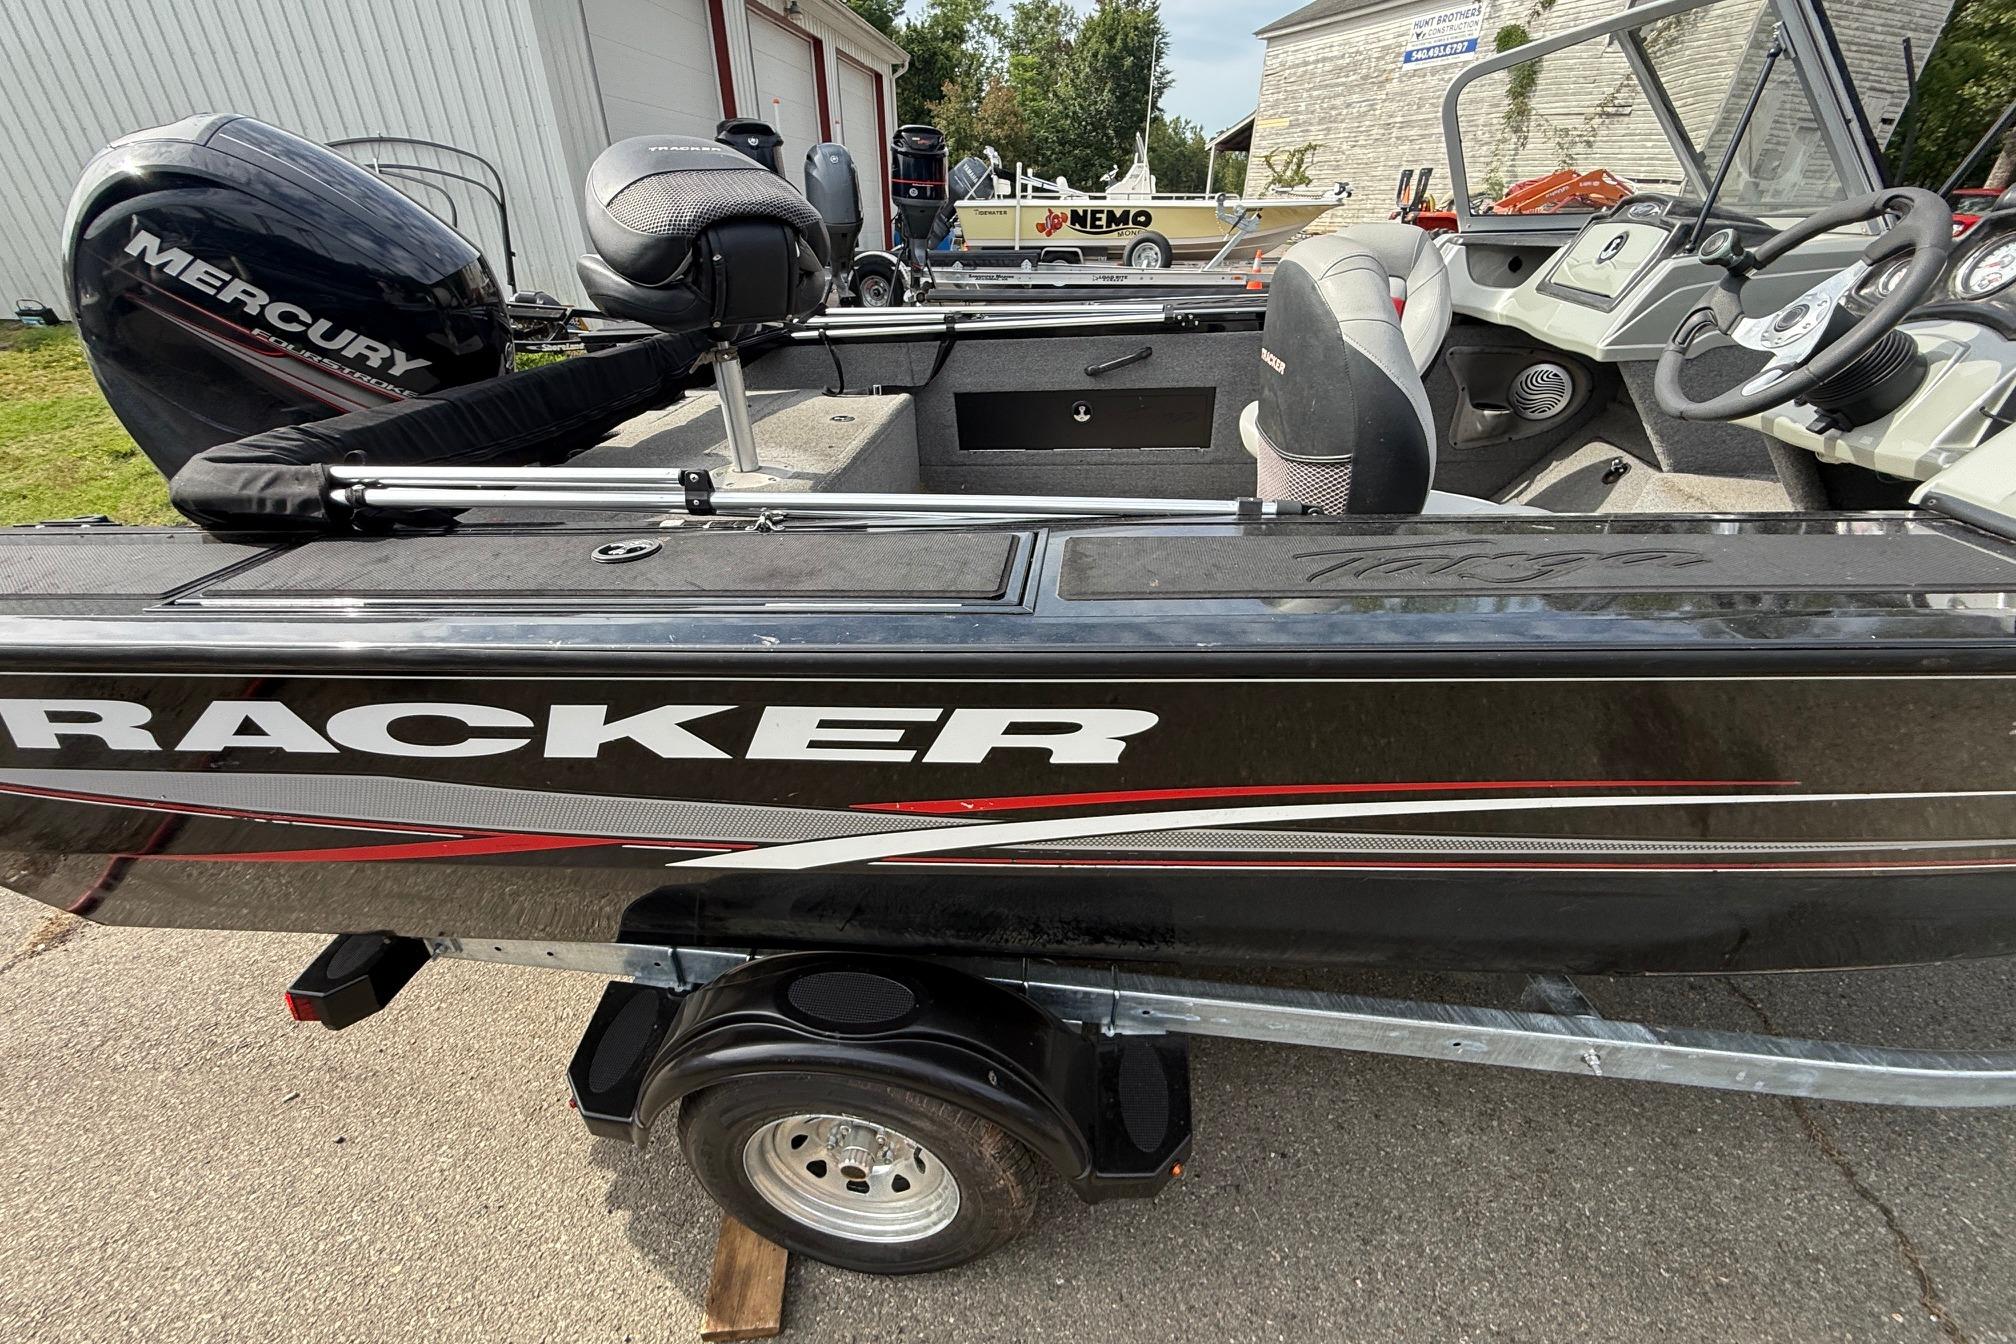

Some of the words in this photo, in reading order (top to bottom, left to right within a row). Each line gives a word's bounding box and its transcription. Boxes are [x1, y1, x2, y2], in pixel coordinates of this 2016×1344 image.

[1413, 17, 1435, 30] HUNT
[1437, 7, 1481, 25] BROTHERS
[1428, 20, 1480, 36] CONSTRUCTION
[1410, 41, 1469, 61] 540.493.6797
[963, 163, 979, 184] YAMAHA
[1070, 209, 1153, 230] NEMO
[123, 229, 433, 377] MERCURY
[251, 328, 421, 399] FOURSTROKE
